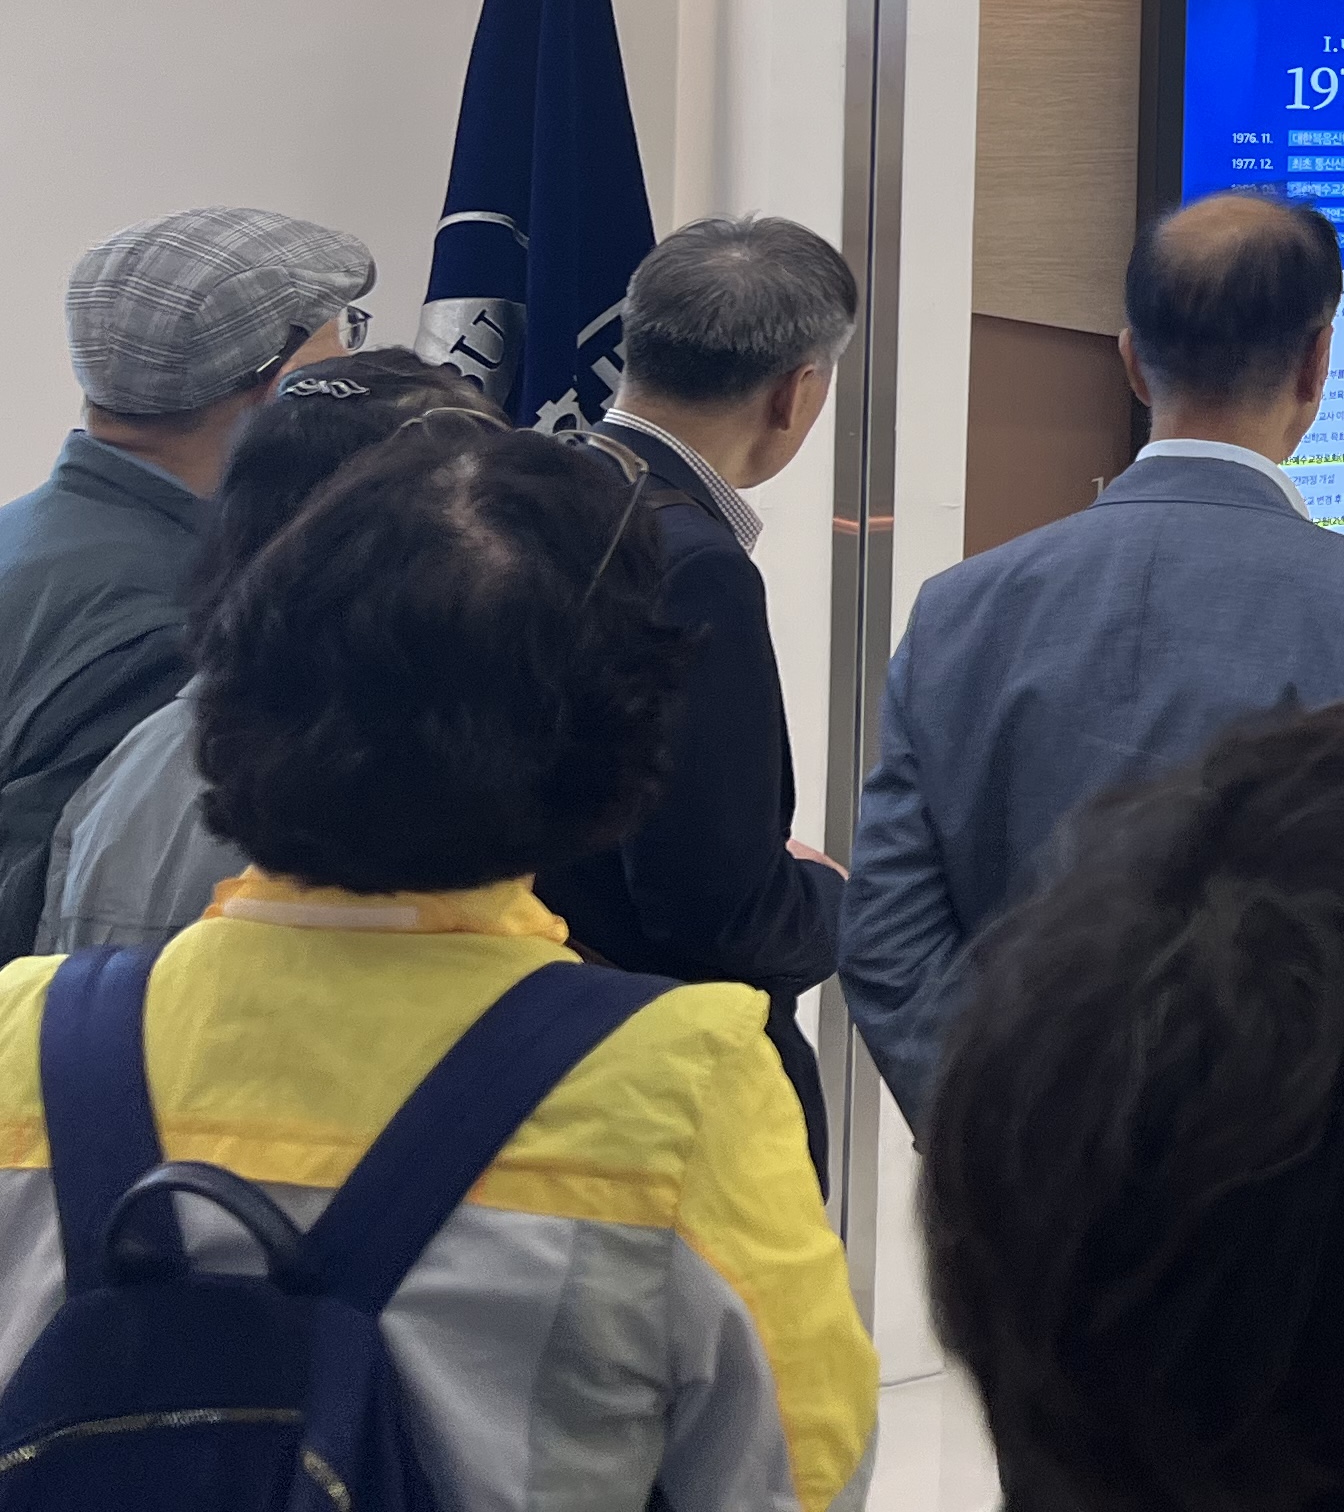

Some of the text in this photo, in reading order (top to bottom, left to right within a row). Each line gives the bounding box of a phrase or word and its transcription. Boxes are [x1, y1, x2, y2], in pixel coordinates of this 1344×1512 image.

[1232, 133, 1259, 144] 1976.
[1261, 133, 1273, 144] 11.
[1232, 158, 1257, 170] 1977.
[1260, 158, 1273, 170] 12.
[1292, 158, 1312, 170] 최초
